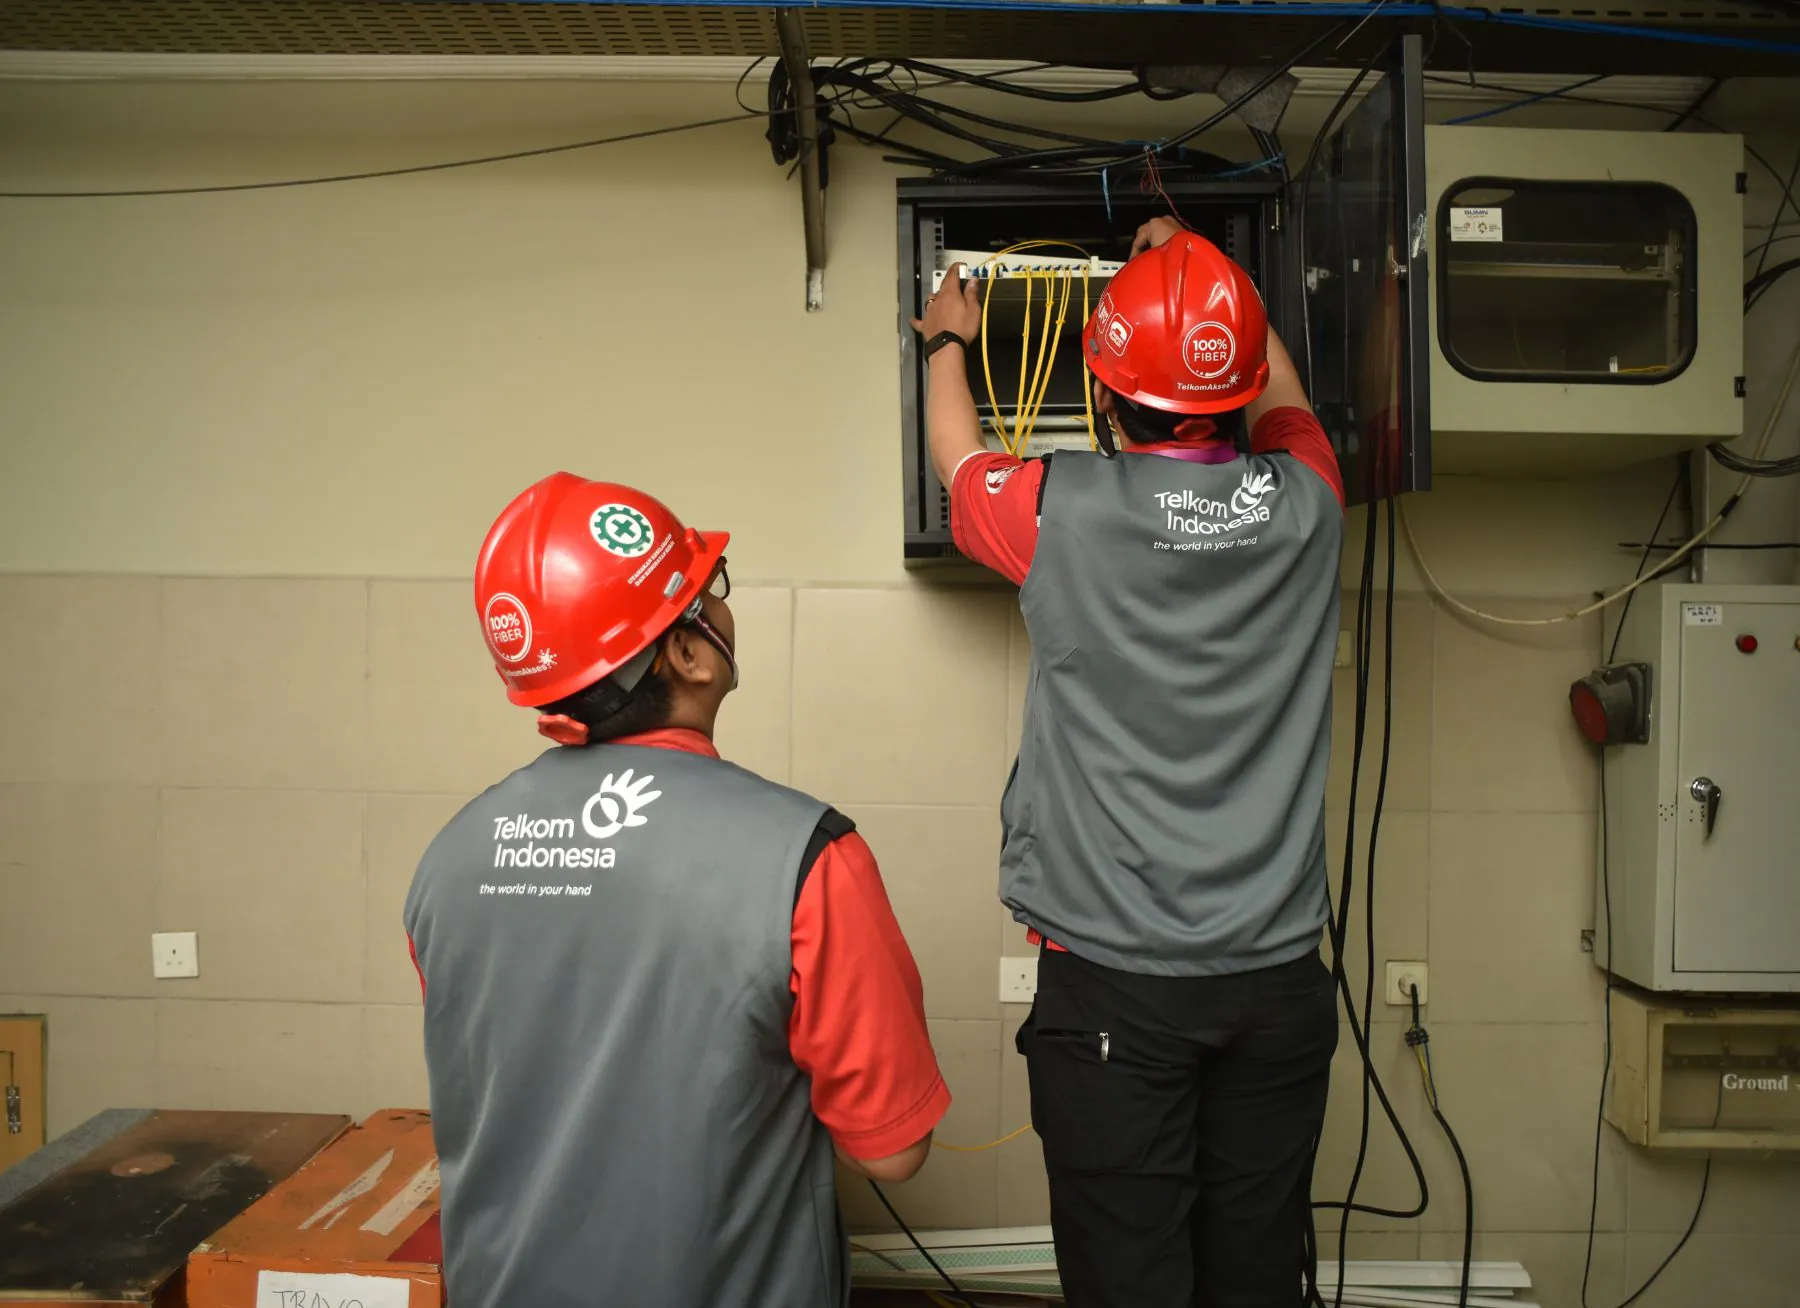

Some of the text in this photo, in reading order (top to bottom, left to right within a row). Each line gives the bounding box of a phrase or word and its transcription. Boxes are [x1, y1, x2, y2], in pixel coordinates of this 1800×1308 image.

[1193, 339, 1228, 351] 100%
[1193, 352, 1228, 362] FIBER
[1177, 382, 1230, 391] TelkomAkses
[1154, 489, 1228, 519] Telkom
[1167, 506, 1270, 535] Indonesia
[1153, 536, 1258, 551] the world in your hand
[489, 612, 520, 630] 100%
[494, 628, 523, 643] FIBER
[493, 814, 575, 840] Telkom
[494, 842, 616, 868] Indonesia
[479, 883, 592, 896] the world in your hand
[1722, 1073, 1789, 1091] Ground
